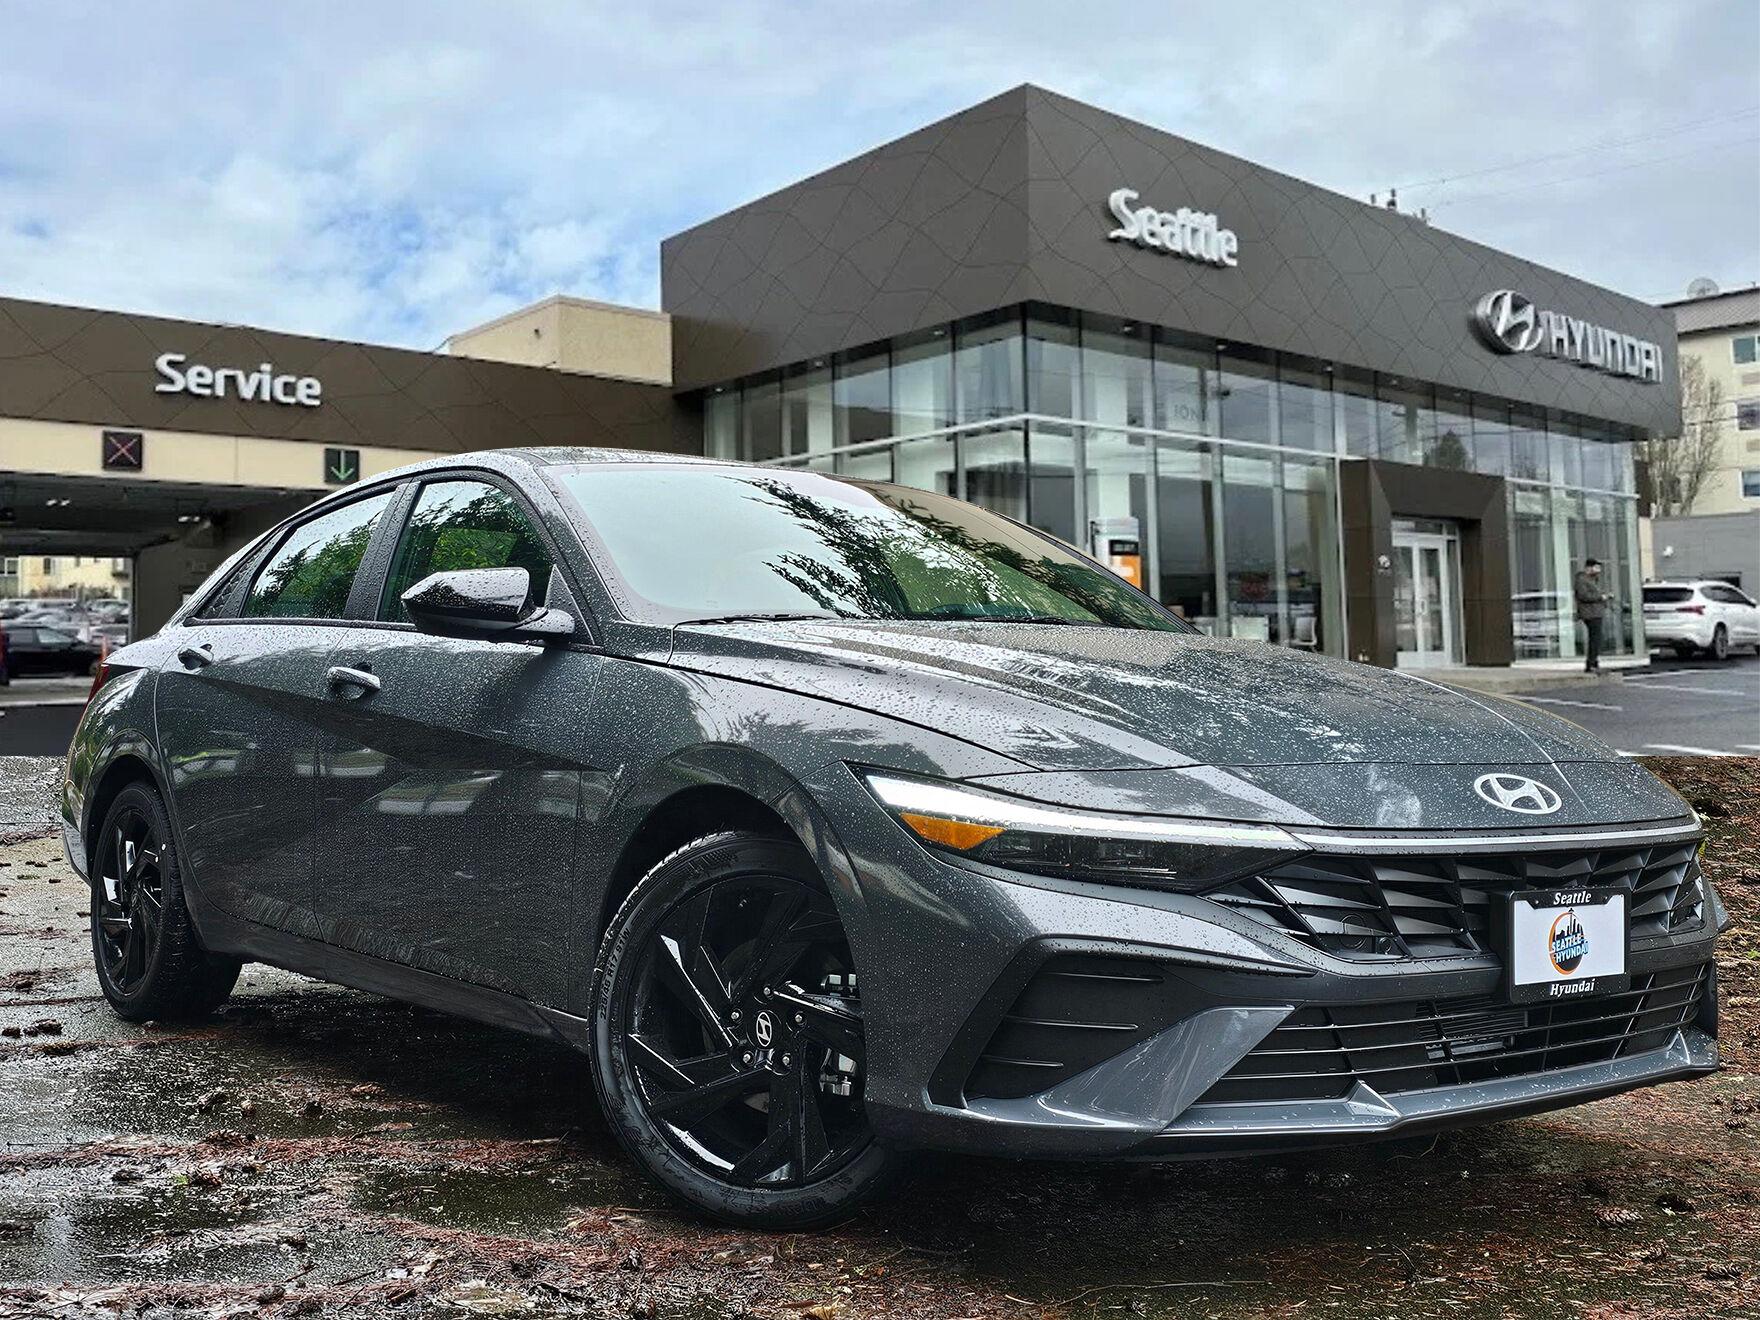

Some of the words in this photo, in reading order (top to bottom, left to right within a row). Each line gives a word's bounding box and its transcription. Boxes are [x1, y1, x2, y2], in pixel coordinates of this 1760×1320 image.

[1108, 188, 1238, 267] Seattle
[1540, 311, 1663, 383] HYUNDAI
[155, 353, 322, 406] Service
[1553, 891, 1592, 905] Seattle
[1552, 934, 1585, 952] SEATTLE
[1556, 940, 1590, 963] HYUNDAI
[607, 954, 618, 977] R17
[1550, 979, 1596, 997] Hyundai
